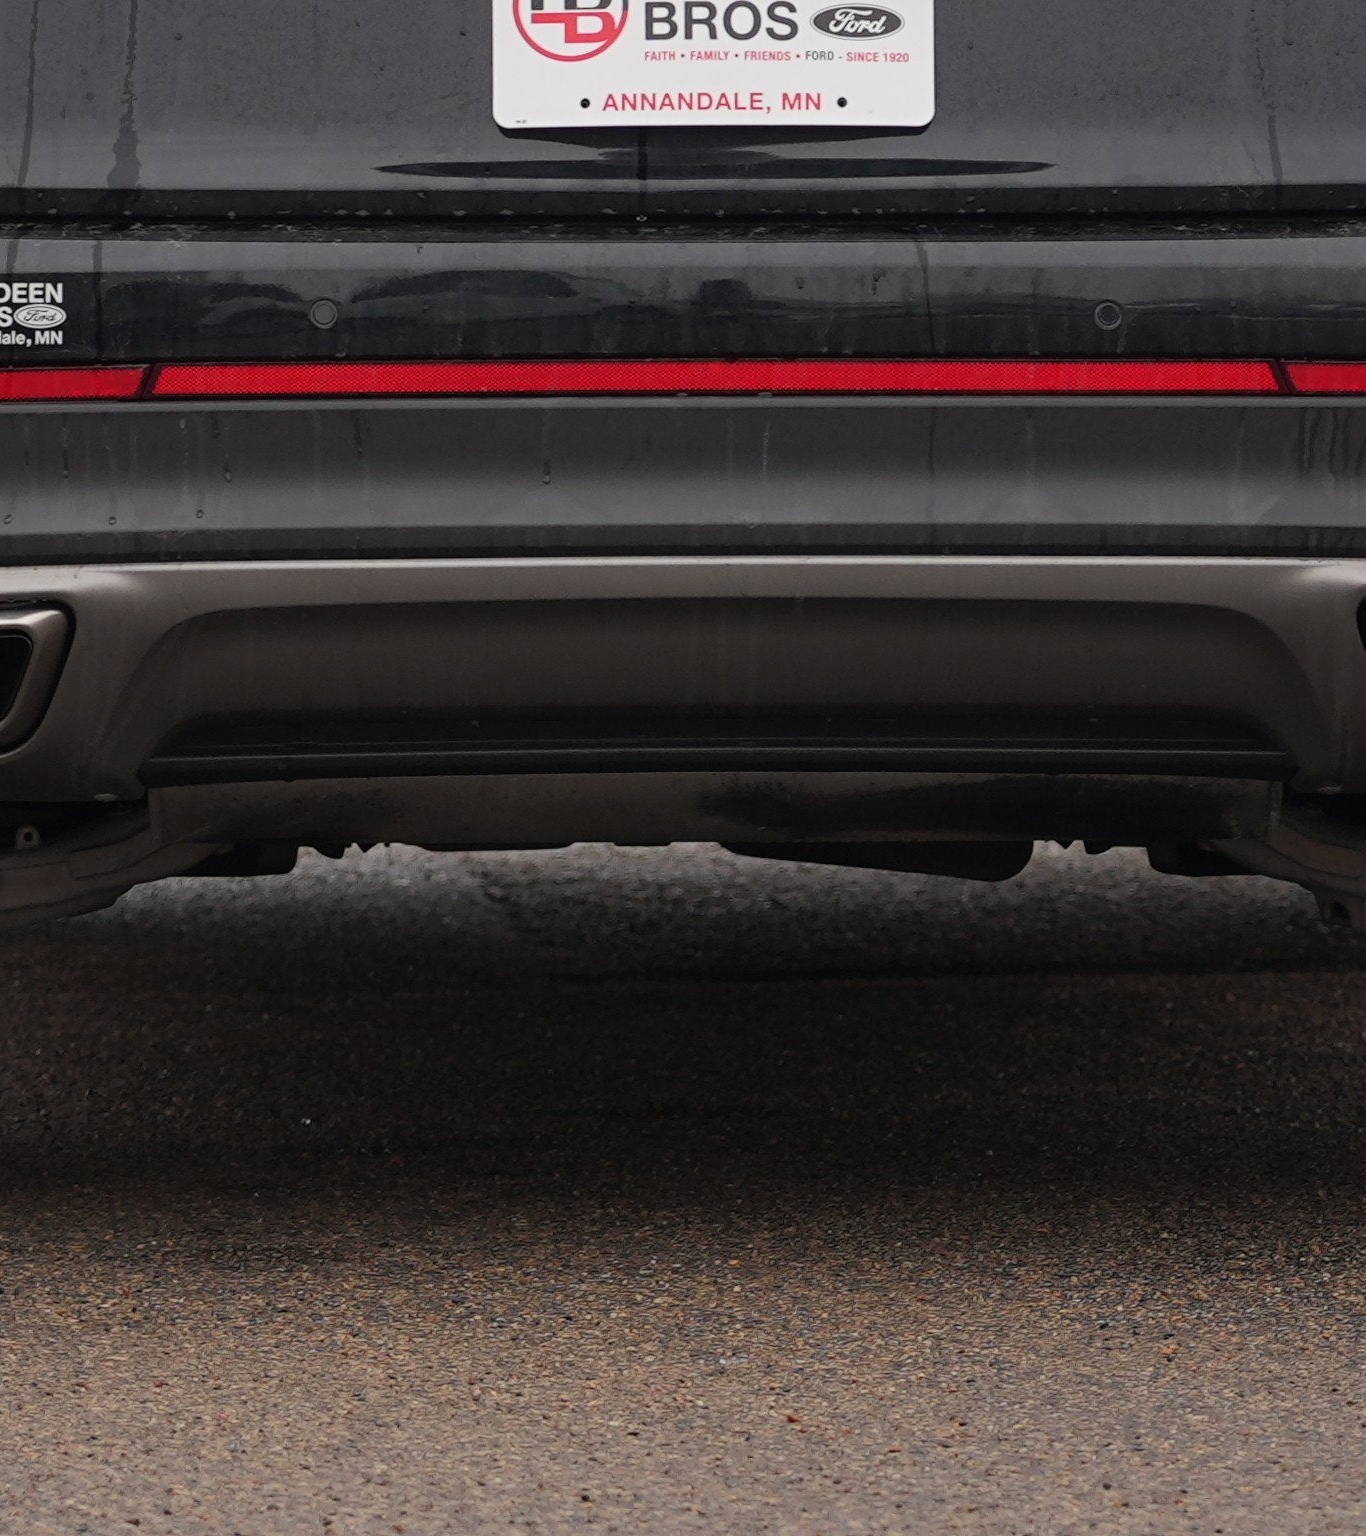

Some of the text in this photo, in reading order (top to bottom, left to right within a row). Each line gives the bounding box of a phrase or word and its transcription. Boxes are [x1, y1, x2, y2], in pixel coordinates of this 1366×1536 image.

[644, 0, 799, 41] BROS
[828, 8, 887, 34] Ford
[644, 50, 910, 63] FAITH FAMILY FRIENDS FORD SINCE 1920
[602, 92, 821, 114] ANNANDALE, MN
[34, 330, 63, 345] MN
